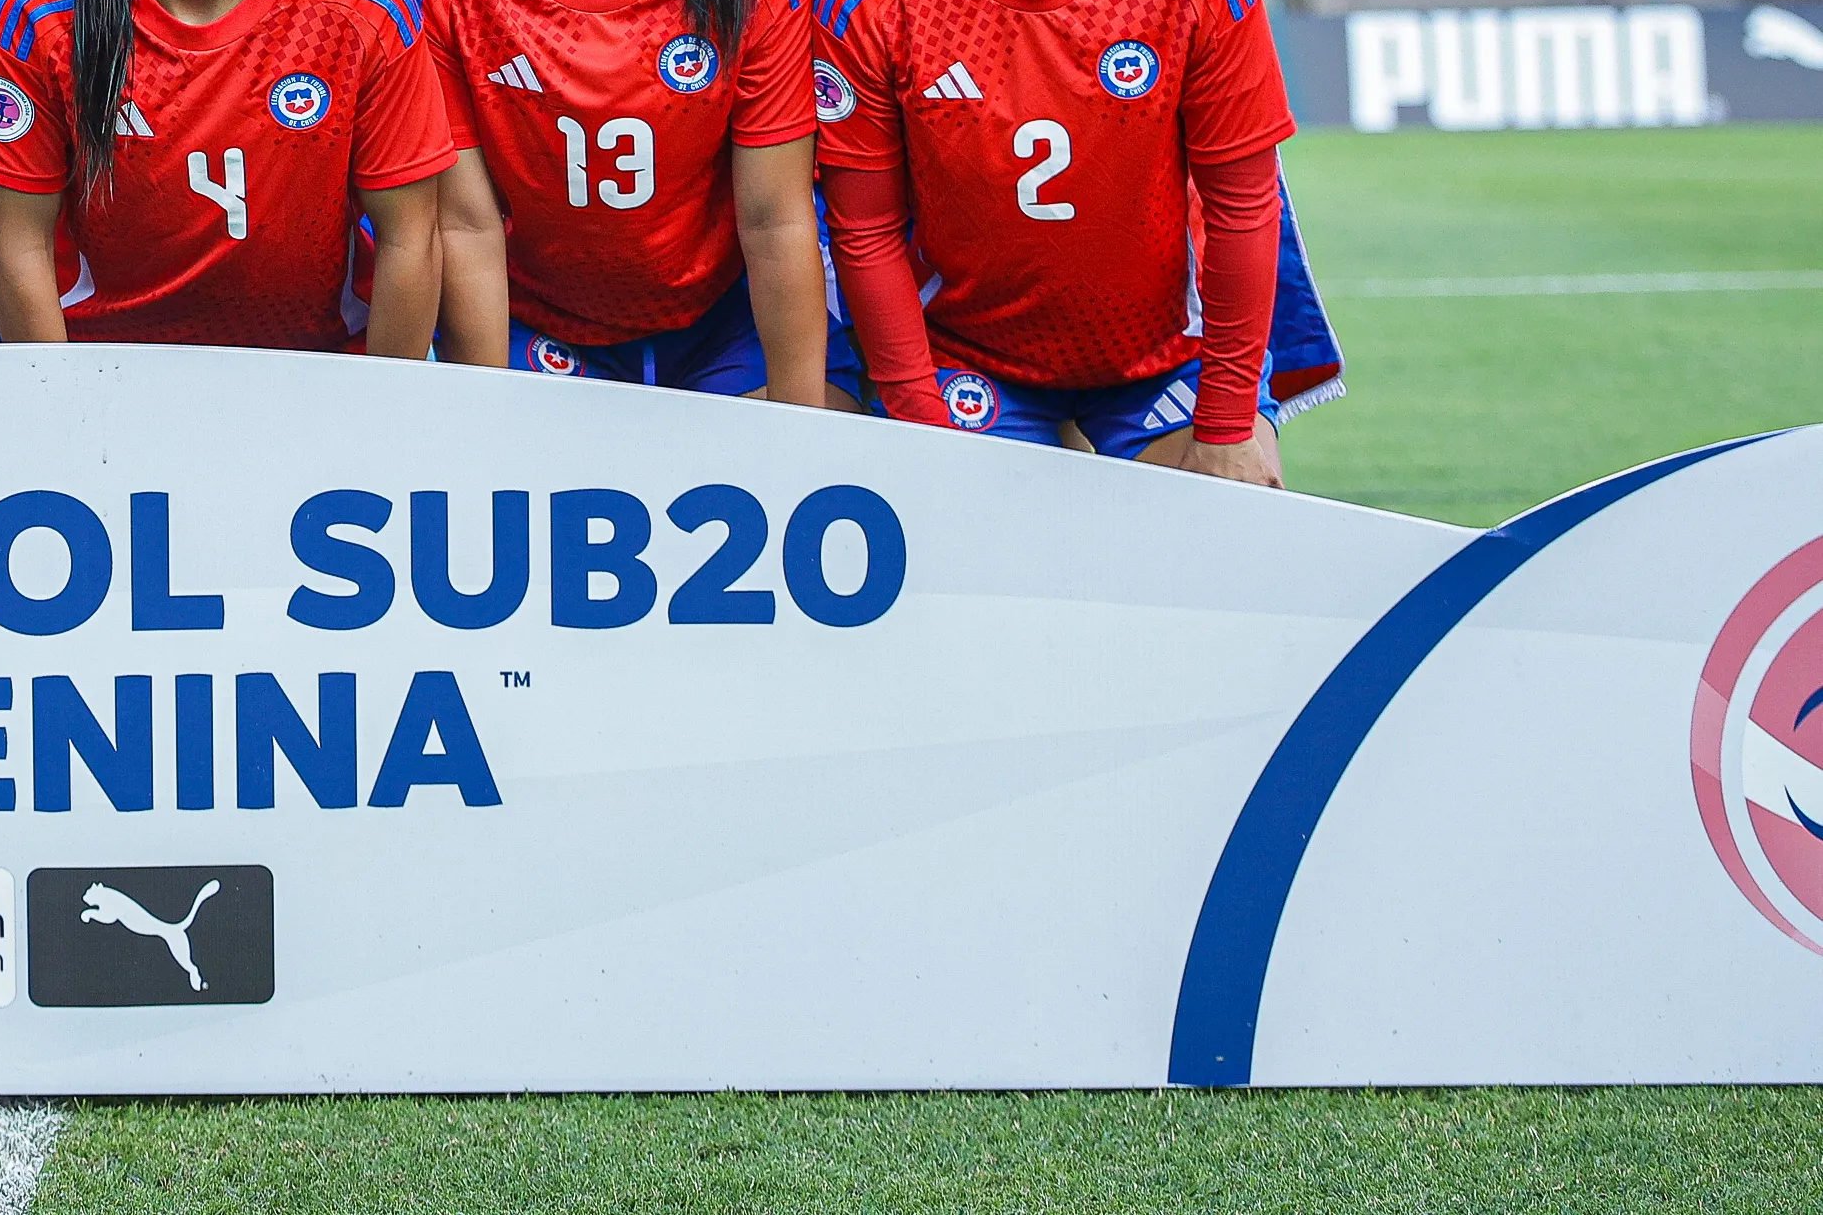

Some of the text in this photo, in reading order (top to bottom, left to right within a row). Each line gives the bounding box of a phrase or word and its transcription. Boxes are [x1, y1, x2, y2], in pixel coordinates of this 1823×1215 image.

[1347, 6, 1707, 132] PUMA
[187, 148, 248, 240] 4
[557, 116, 656, 209] 13
[1012, 119, 1075, 220] 2
[286, 483, 907, 631] SUB20
